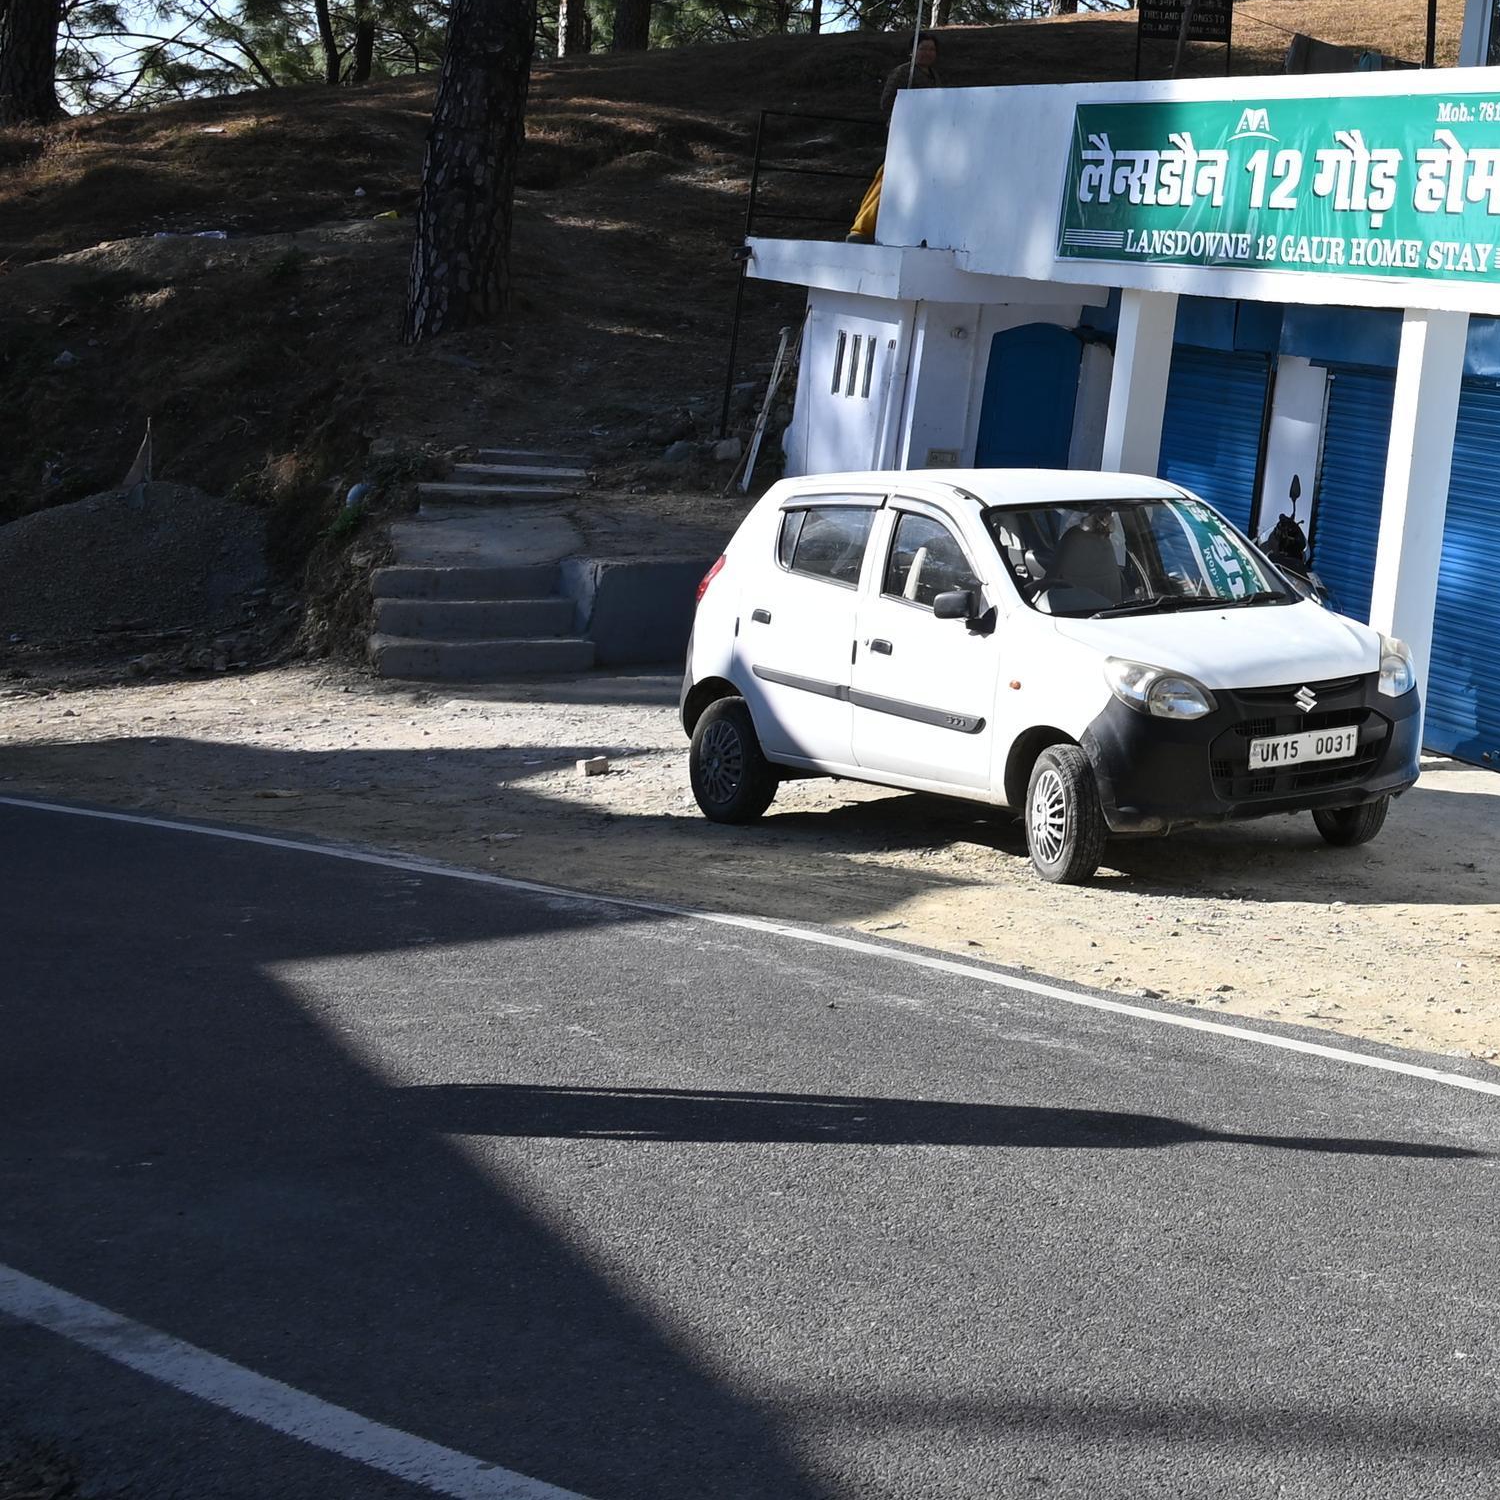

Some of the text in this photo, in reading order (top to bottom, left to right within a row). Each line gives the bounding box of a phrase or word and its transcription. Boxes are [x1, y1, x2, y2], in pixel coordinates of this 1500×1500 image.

[1436, 101, 1475, 122] Mob.:
[1078, 132, 1228, 208] लैन्सडौन
[1245, 149, 1302, 209] 12
[1312, 130, 1403, 228] गौड़
[1124, 228, 1494, 272] LANSDOWNE 12 GAUR HOME STAY
[1260, 740, 1299, 763] UK15
[1315, 733, 1352, 756] 0031
